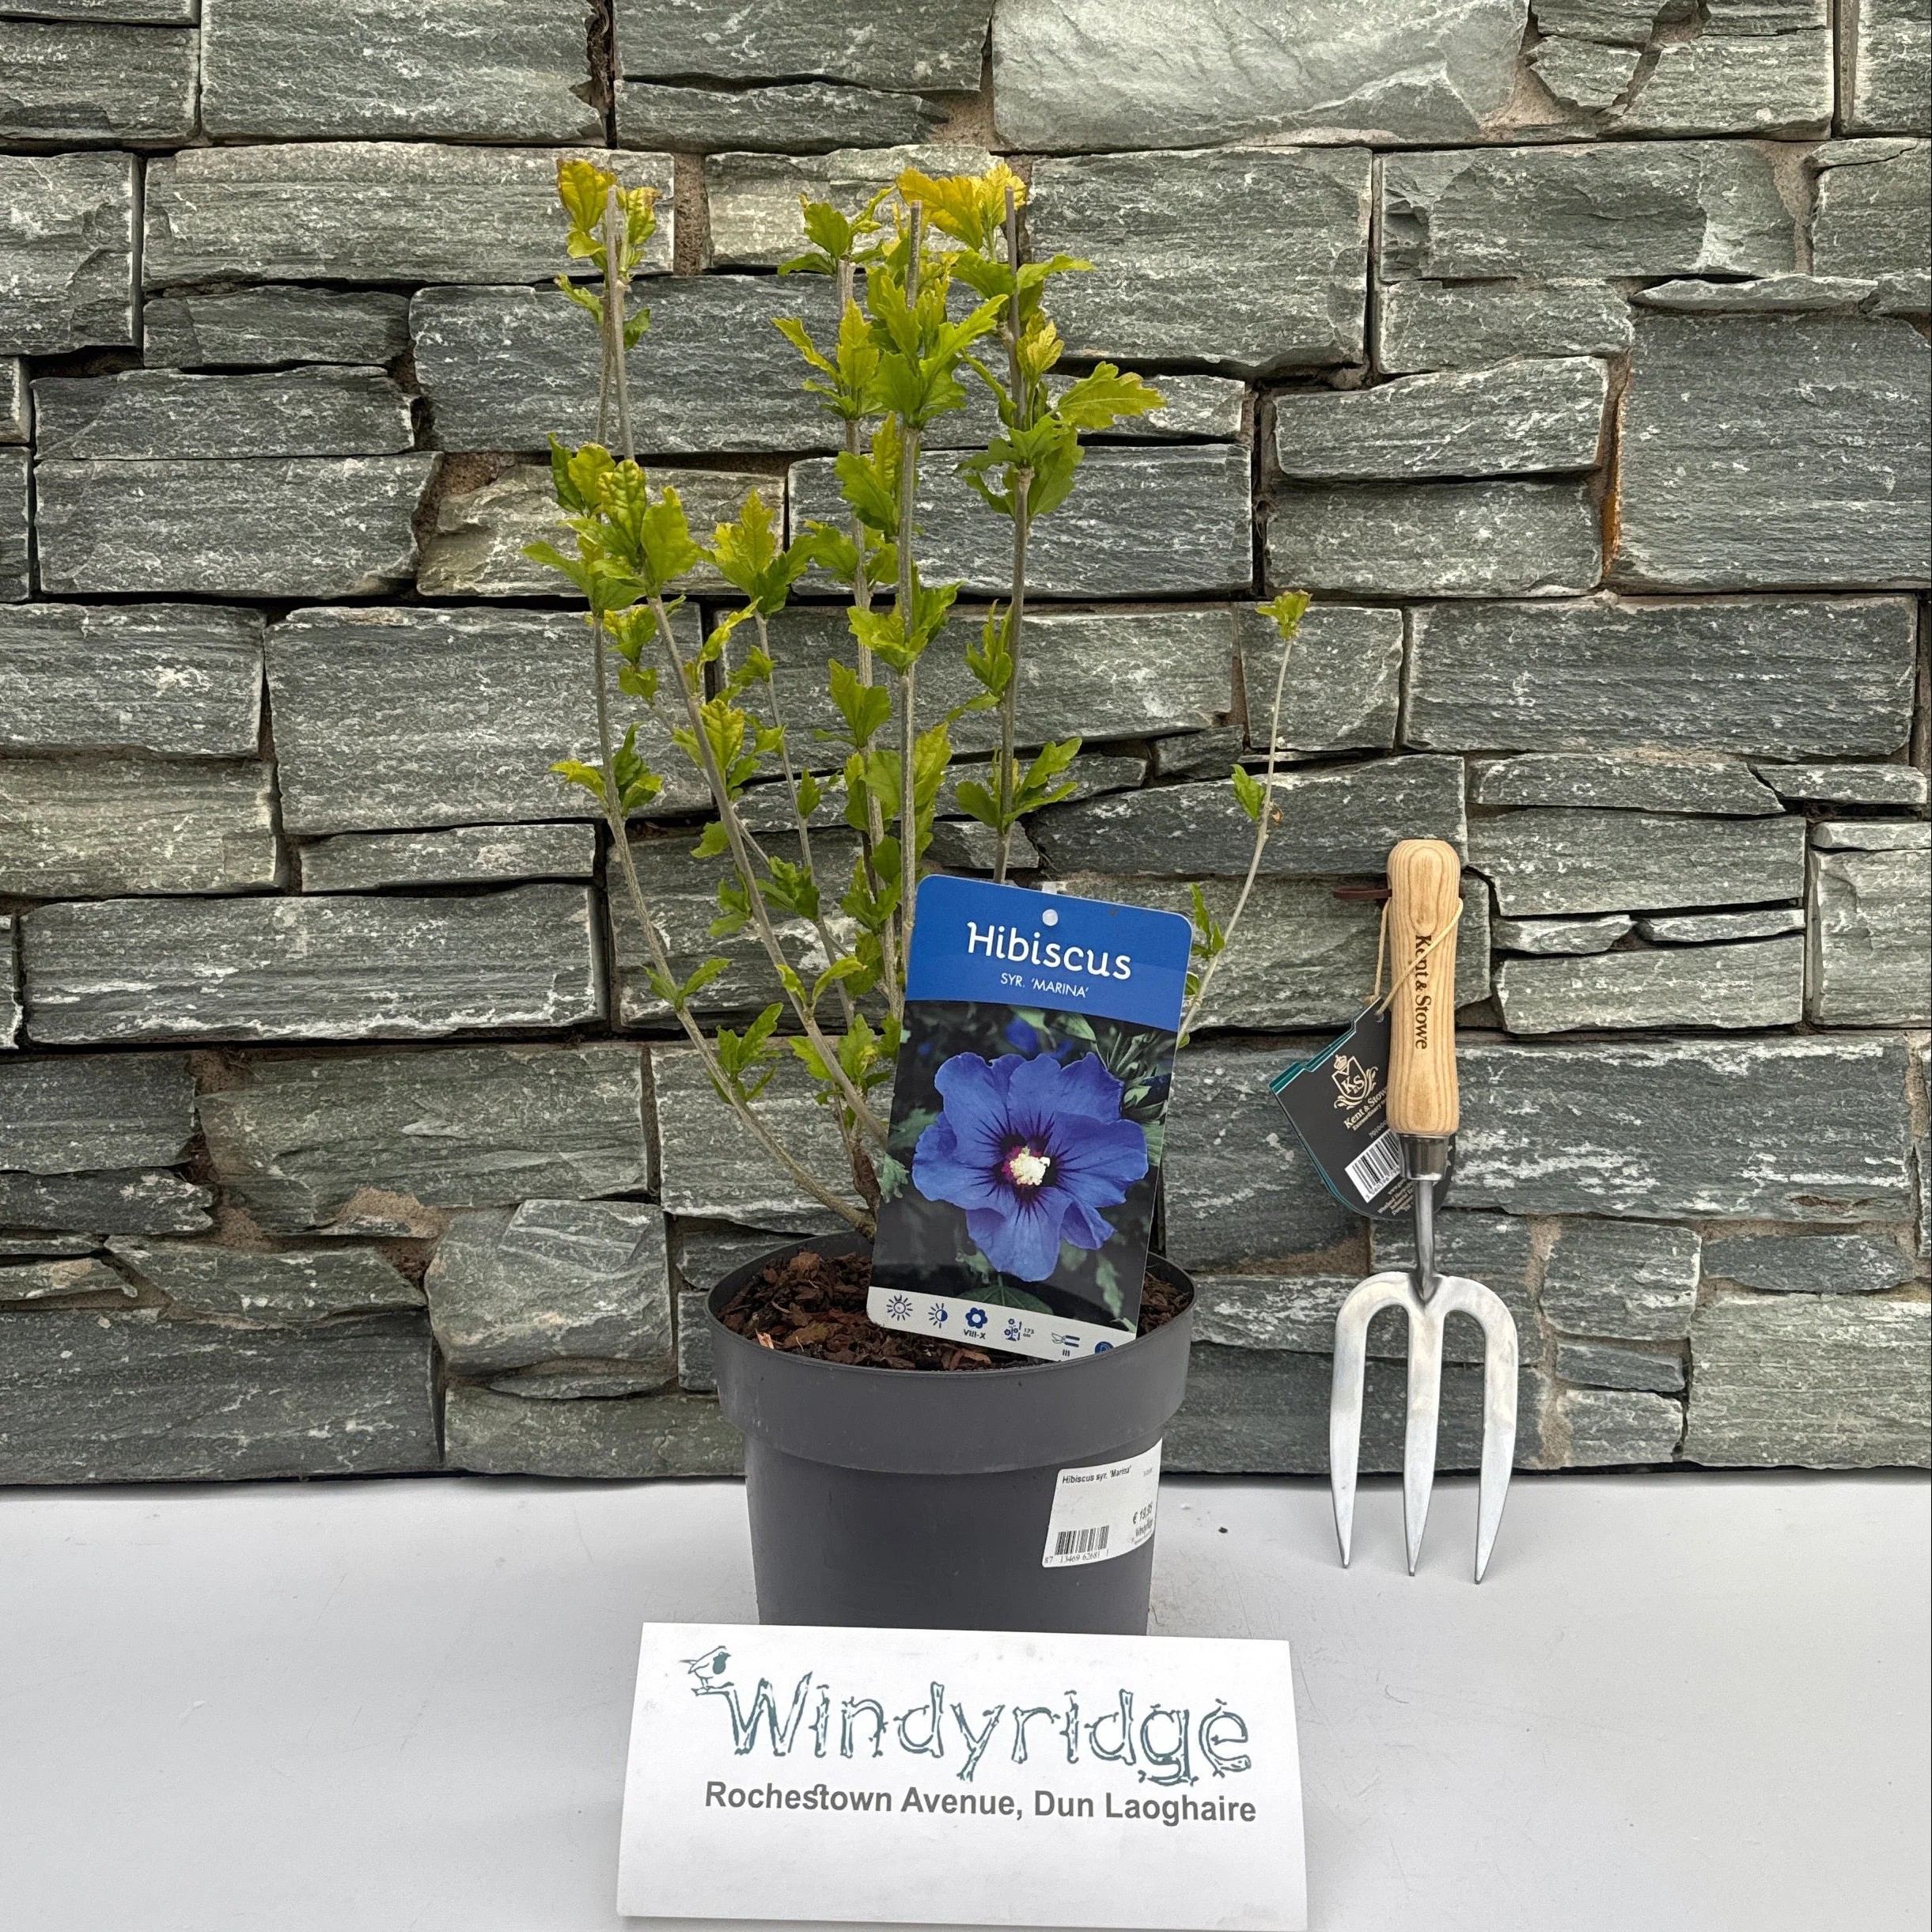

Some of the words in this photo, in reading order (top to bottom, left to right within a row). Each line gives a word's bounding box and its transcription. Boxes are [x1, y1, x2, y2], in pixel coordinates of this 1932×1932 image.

[967, 922, 1131, 979] Hibiscus
[1415, 934, 1432, 978] Kent
[1000, 972, 1025, 987] SYR.
[1031, 978, 1089, 998] 'MARINA'
[1415, 980, 1427, 991] &
[1415, 994, 1432, 1050] Stowe
[1343, 1108, 1365, 1129] Kent
[1367, 1086, 1388, 1107] Stow
[963, 1329, 987, 1340] VIII-X
[1063, 1474, 1094, 1484] Hibiscus
[690, 1670, 1252, 1786] Windyridge
[704, 1782, 891, 1812] Rochestown
[901, 1787, 1021, 1820] Avenue,
[1036, 1790, 1093, 1816] Dun
[1106, 1793, 1256, 1826] Laoghaire
